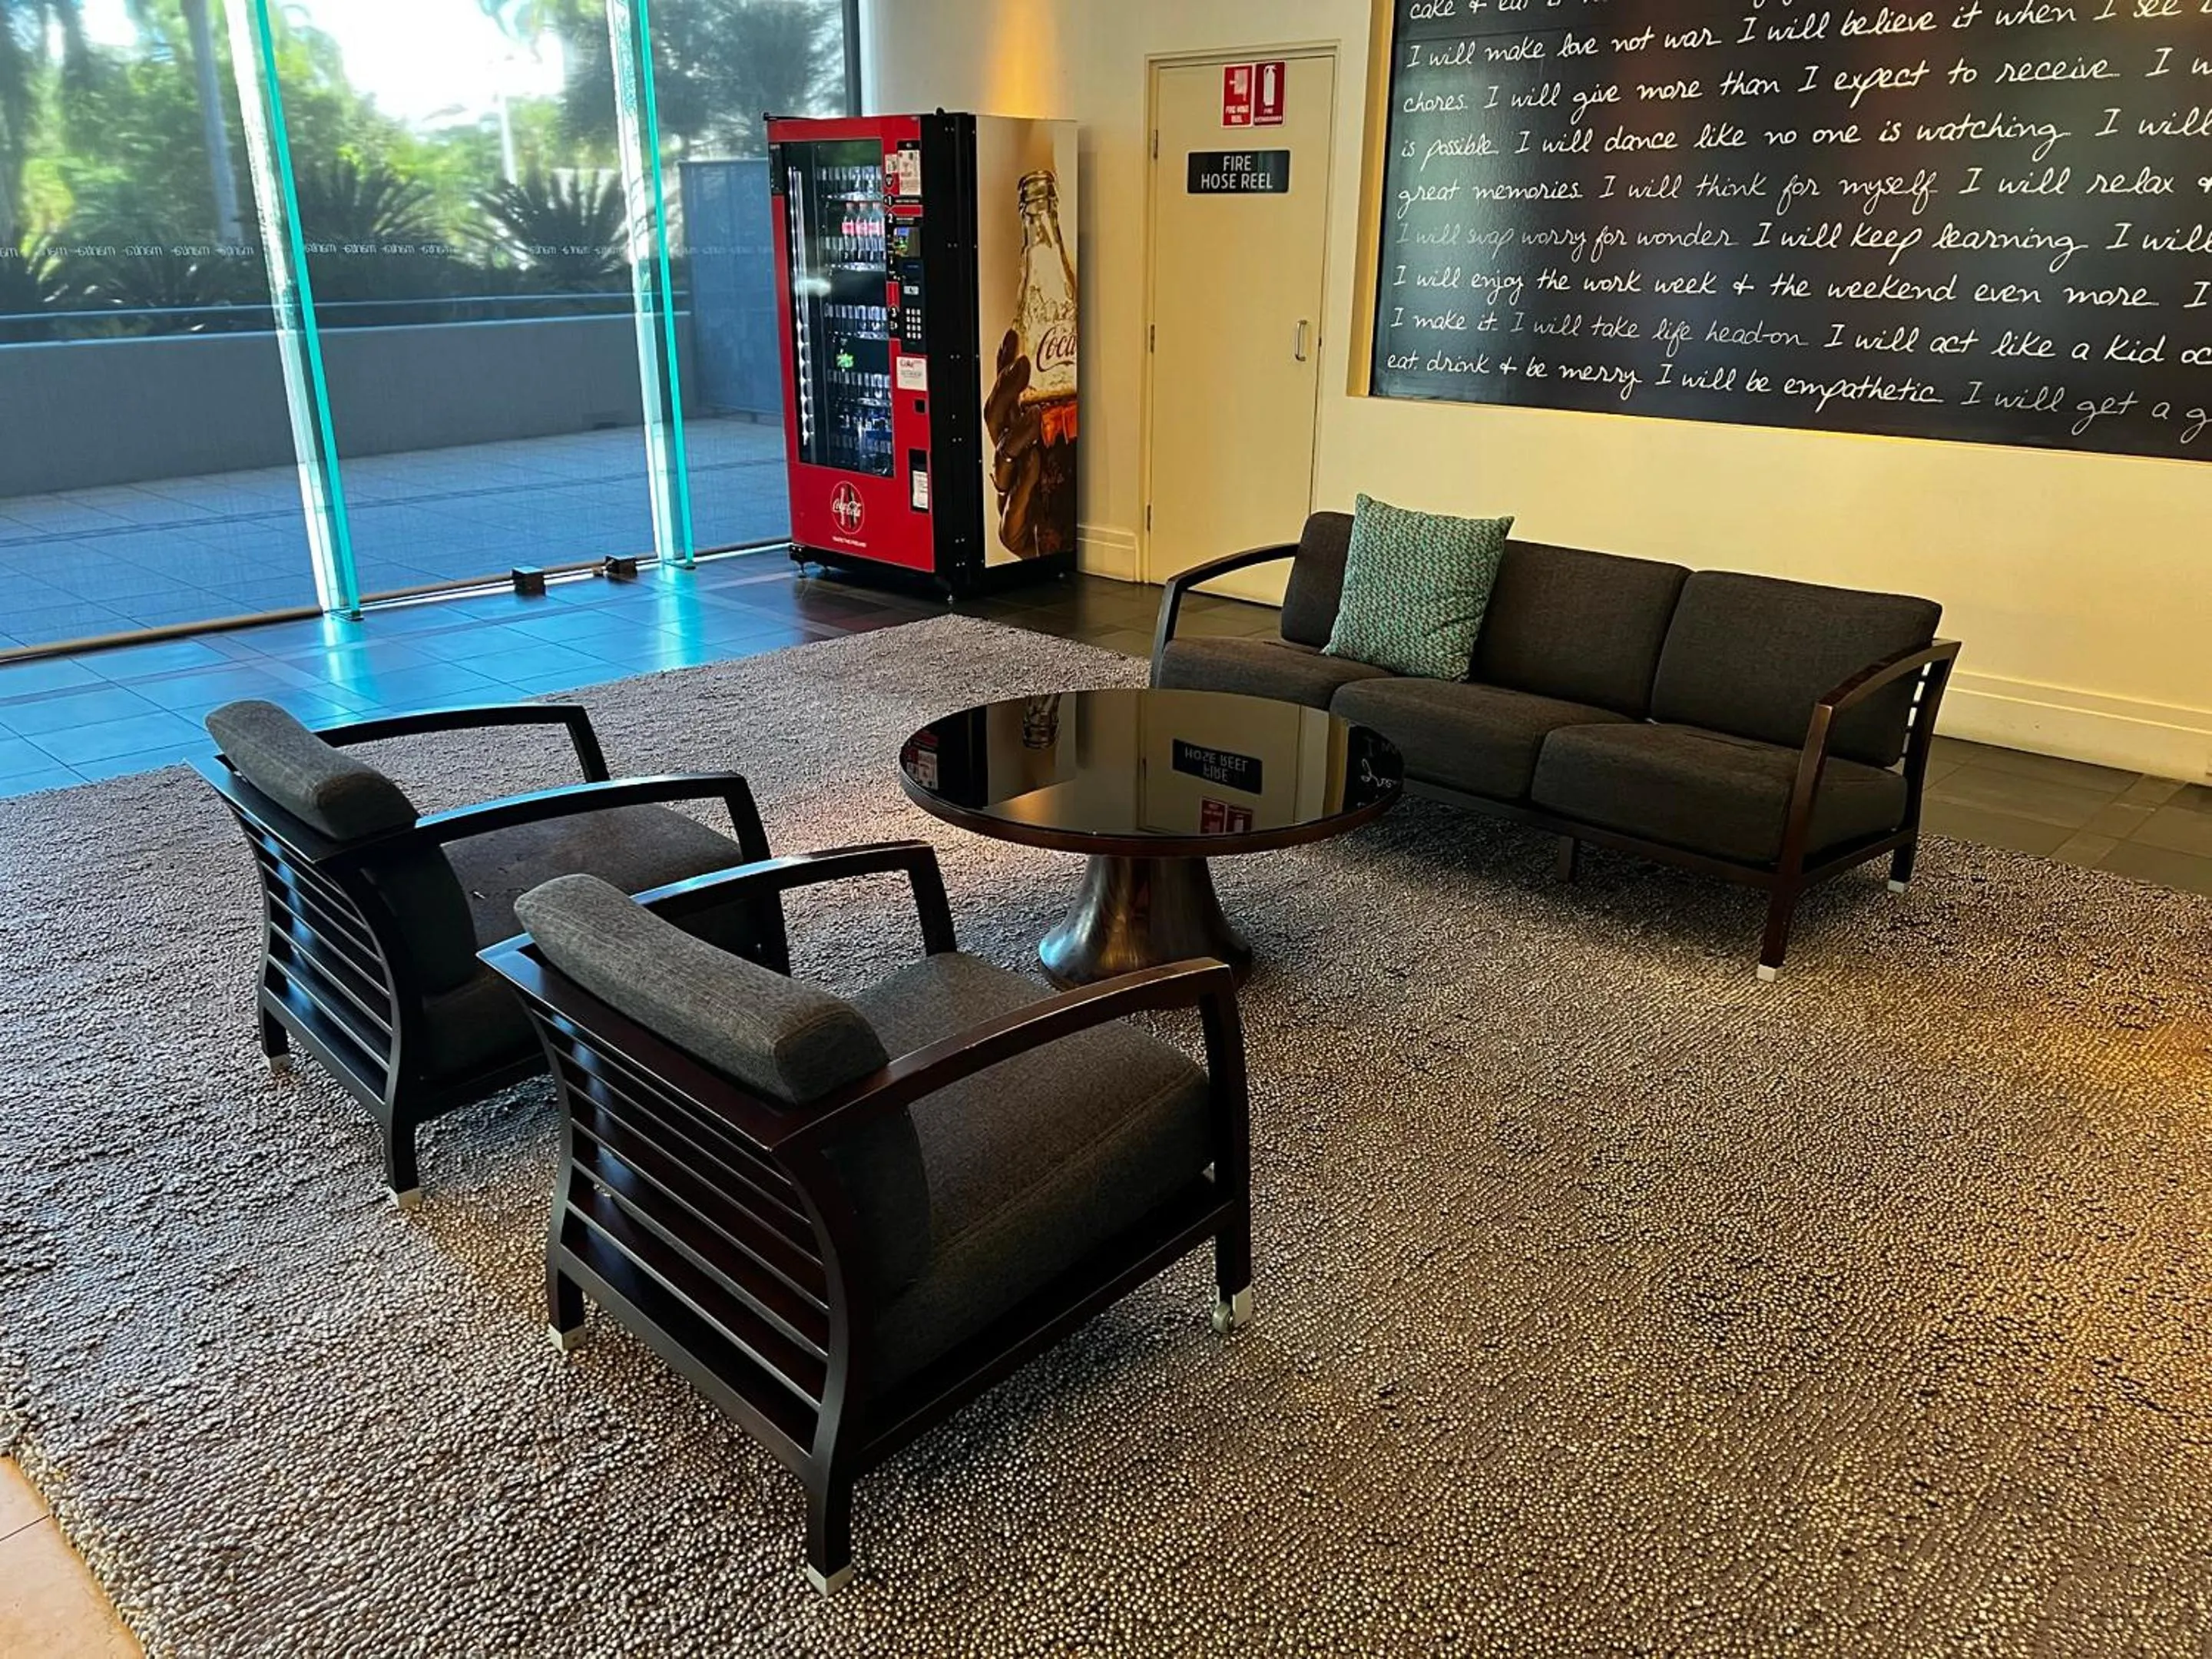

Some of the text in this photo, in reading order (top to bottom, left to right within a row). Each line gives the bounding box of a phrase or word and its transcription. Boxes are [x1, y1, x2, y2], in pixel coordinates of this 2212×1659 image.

[1407, 45, 1421, 68] I
[1429, 41, 1475, 66] will
[1485, 35, 1546, 61] make
[1557, 32, 1599, 58] love
[1611, 25, 1655, 52] not
[1736, 16, 1757, 44] I
[1767, 12, 1830, 41] will
[1840, 7, 1937, 36] believe
[1951, 0, 1982, 28] it
[1995, 0, 2077, 25] when
[2093, 0, 2117, 21] I
[2133, 0, 2183, 18] see
[1409, 0, 1456, 19] cake
[1484, 85, 1498, 108] I
[1512, 82, 1561, 108] will
[1570, 84, 1621, 125] give
[1637, 81, 1703, 100] more
[1720, 71, 1780, 96] than
[1797, 65, 1820, 92] I
[1834, 60, 1930, 108] expect
[1948, 57, 1978, 84] to
[2145, 47, 2173, 77] I
[1401, 140, 1415, 157] is
[1515, 131, 1530, 154] I
[1542, 127, 1593, 153] will
[1604, 125, 1678, 152] dance
[1694, 122, 1747, 148] like
[1763, 131, 1797, 145] no
[1813, 124, 1862, 144] one
[1879, 121, 1902, 142] is
[2095, 108, 2121, 136] I
[1201, 173, 1273, 189] HOSE REEL
[1223, 155, 1251, 171] FIRE
[1396, 180, 1460, 218] great
[1598, 175, 1616, 198] I
[1628, 174, 1682, 198] will
[1696, 172, 1767, 197] think
[1777, 174, 1820, 216] for
[1959, 167, 1982, 194] I
[1998, 167, 2071, 194] will
[2086, 166, 2174, 194] relax
[1396, 223, 1409, 243] I
[1417, 224, 1461, 245] will
[1467, 228, 1515, 260] swap
[1522, 229, 1587, 263] worry
[1591, 225, 1628, 263] for
[1753, 222, 1773, 247] I
[1781, 222, 1843, 248] will
[2105, 223, 2132, 250] I
[1393, 265, 1406, 285] I
[1417, 267, 1460, 288] will
[1471, 269, 1525, 306] enjoy
[1536, 268, 1571, 290] the
[1583, 269, 1641, 293] work
[1654, 271, 1717, 294] week
[1733, 273, 1754, 295] &
[1770, 273, 1811, 296] the
[1828, 274, 1957, 302] weekend
[1974, 284, 2041, 303] even
[2183, 281, 2212, 308] I
[1390, 307, 1404, 327] I
[1412, 310, 1467, 330] make
[1510, 312, 1525, 332] I
[1534, 314, 1581, 336] will
[1590, 315, 1640, 338] take
[1651, 318, 1693, 357] life
[1823, 324, 1845, 347] I
[1855, 326, 1919, 353] will
[1930, 329, 1979, 354] act
[1991, 330, 2056, 357] like
[2071, 343, 2090, 360] a
[1427, 350, 1489, 373] drink
[1499, 356, 1518, 375] &
[1525, 356, 1548, 377] be
[1655, 364, 1673, 385] I
[1682, 367, 1736, 391] will
[1746, 369, 1772, 392] be
[1960, 381, 1983, 405] I
[1995, 386, 2065, 412] will
[2071, 391, 2138, 435] get
[2151, 402, 2170, 419] a
